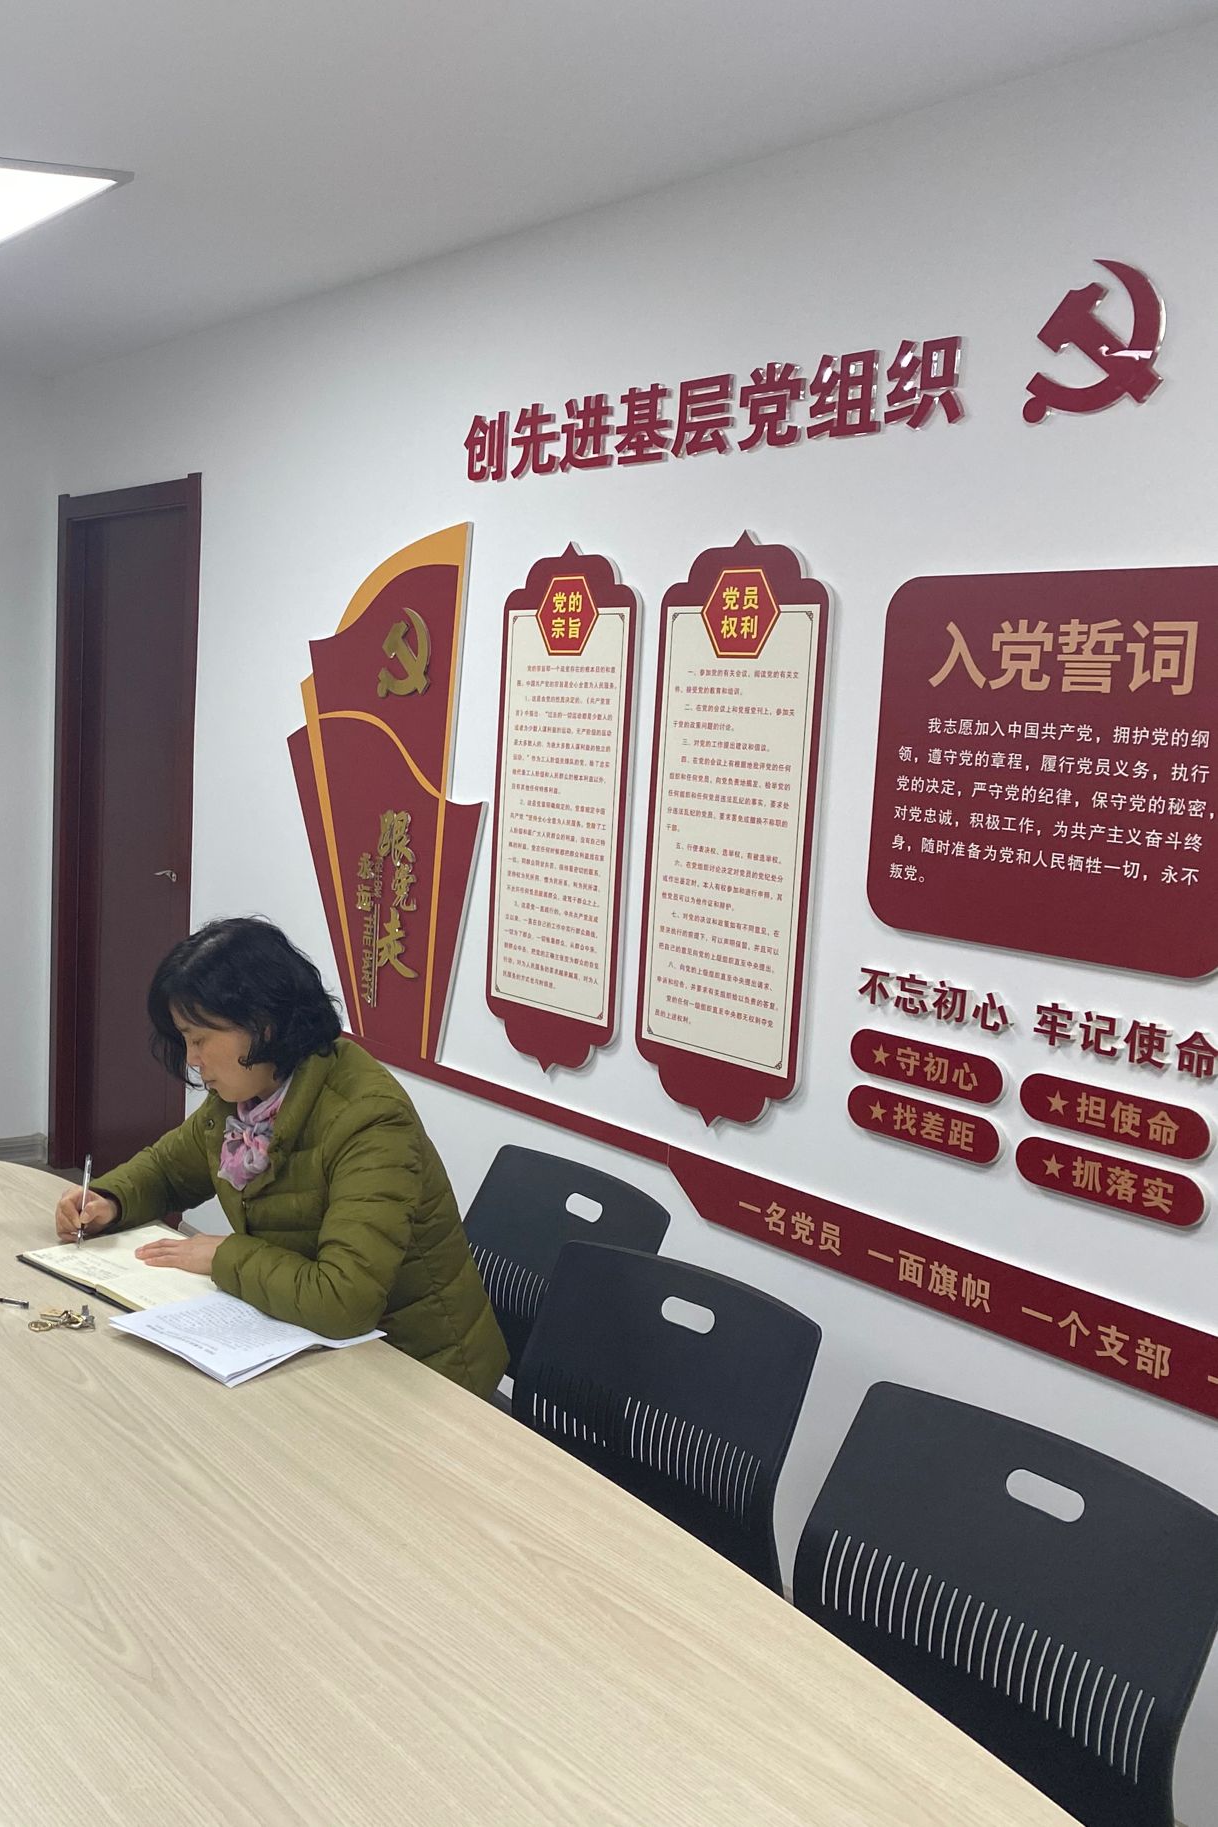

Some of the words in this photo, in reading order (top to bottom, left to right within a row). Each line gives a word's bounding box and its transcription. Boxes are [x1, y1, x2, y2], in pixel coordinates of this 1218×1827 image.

[464, 336, 965, 481] 创先进基层党组织
[552, 591, 583, 614] 党的
[722, 587, 759, 611] 党员
[551, 617, 582, 640] 宗旨
[720, 615, 759, 639] 权利
[928, 618, 1199, 696] 入党誓词
[928, 717, 1210, 748] 我志愿加入中国共产党，拥护党的纲
[898, 746, 1210, 784] 领，遵守党的章程，履行党员义务，执行
[896, 776, 1216, 820] 党的决定，严守党的纪律，保守党的秘密，
[893, 806, 1203, 852] 对党忠诚，积极工作，为共产主义奋斗终
[889, 863, 926, 884] 叛党。
[891, 834, 1200, 886] 身，随时准备为党和人民牺牲一切，永不
[859, 967, 1010, 1033] 不忘初心
[1033, 1003, 1218, 1079] 牢记使命
[896, 1046, 978, 1092] 守初心
[892, 1102, 976, 1153] 找差距
[1076, 1092, 1180, 1147] 担使命
[1072, 1157, 1175, 1214] 抓落实
[739, 1200, 842, 1257] 一名党员
[868, 1248, 992, 1314] 一面旗帜
[1021, 1305, 1173, 1380] 一个支部
